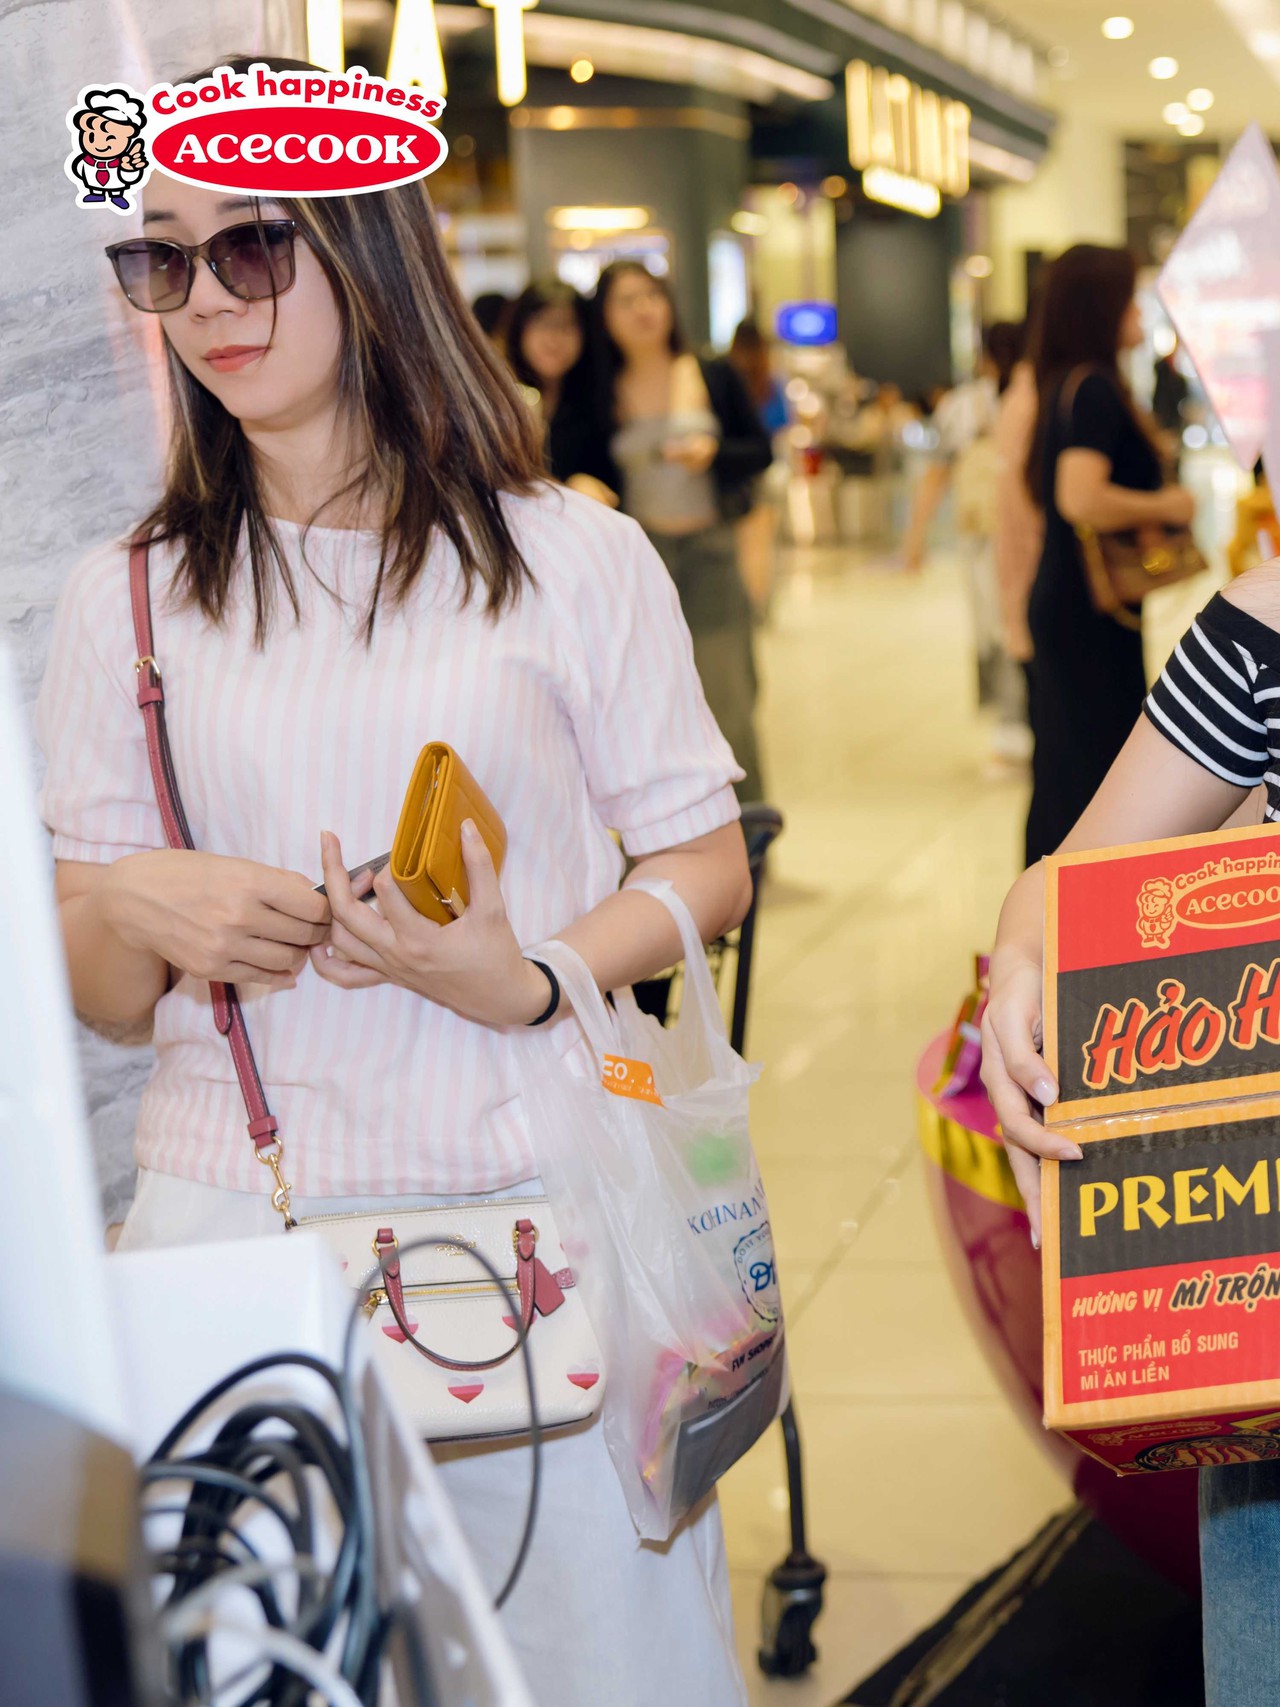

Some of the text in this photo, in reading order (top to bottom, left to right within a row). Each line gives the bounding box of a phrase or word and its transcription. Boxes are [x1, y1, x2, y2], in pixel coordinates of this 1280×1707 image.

[1174, 864, 1219, 890] Cook
[1084, 980, 1224, 1086] Hảo
[1072, 1290, 1138, 1318] HƯƠNG
[1143, 1288, 1162, 1312] VỊ
[1171, 1271, 1211, 1311] MÌ
[1078, 1329, 1239, 1369] THỰC PHẨM BỔ SUNG
[1080, 1360, 1170, 1391] MÌ ĂN LIỀN
